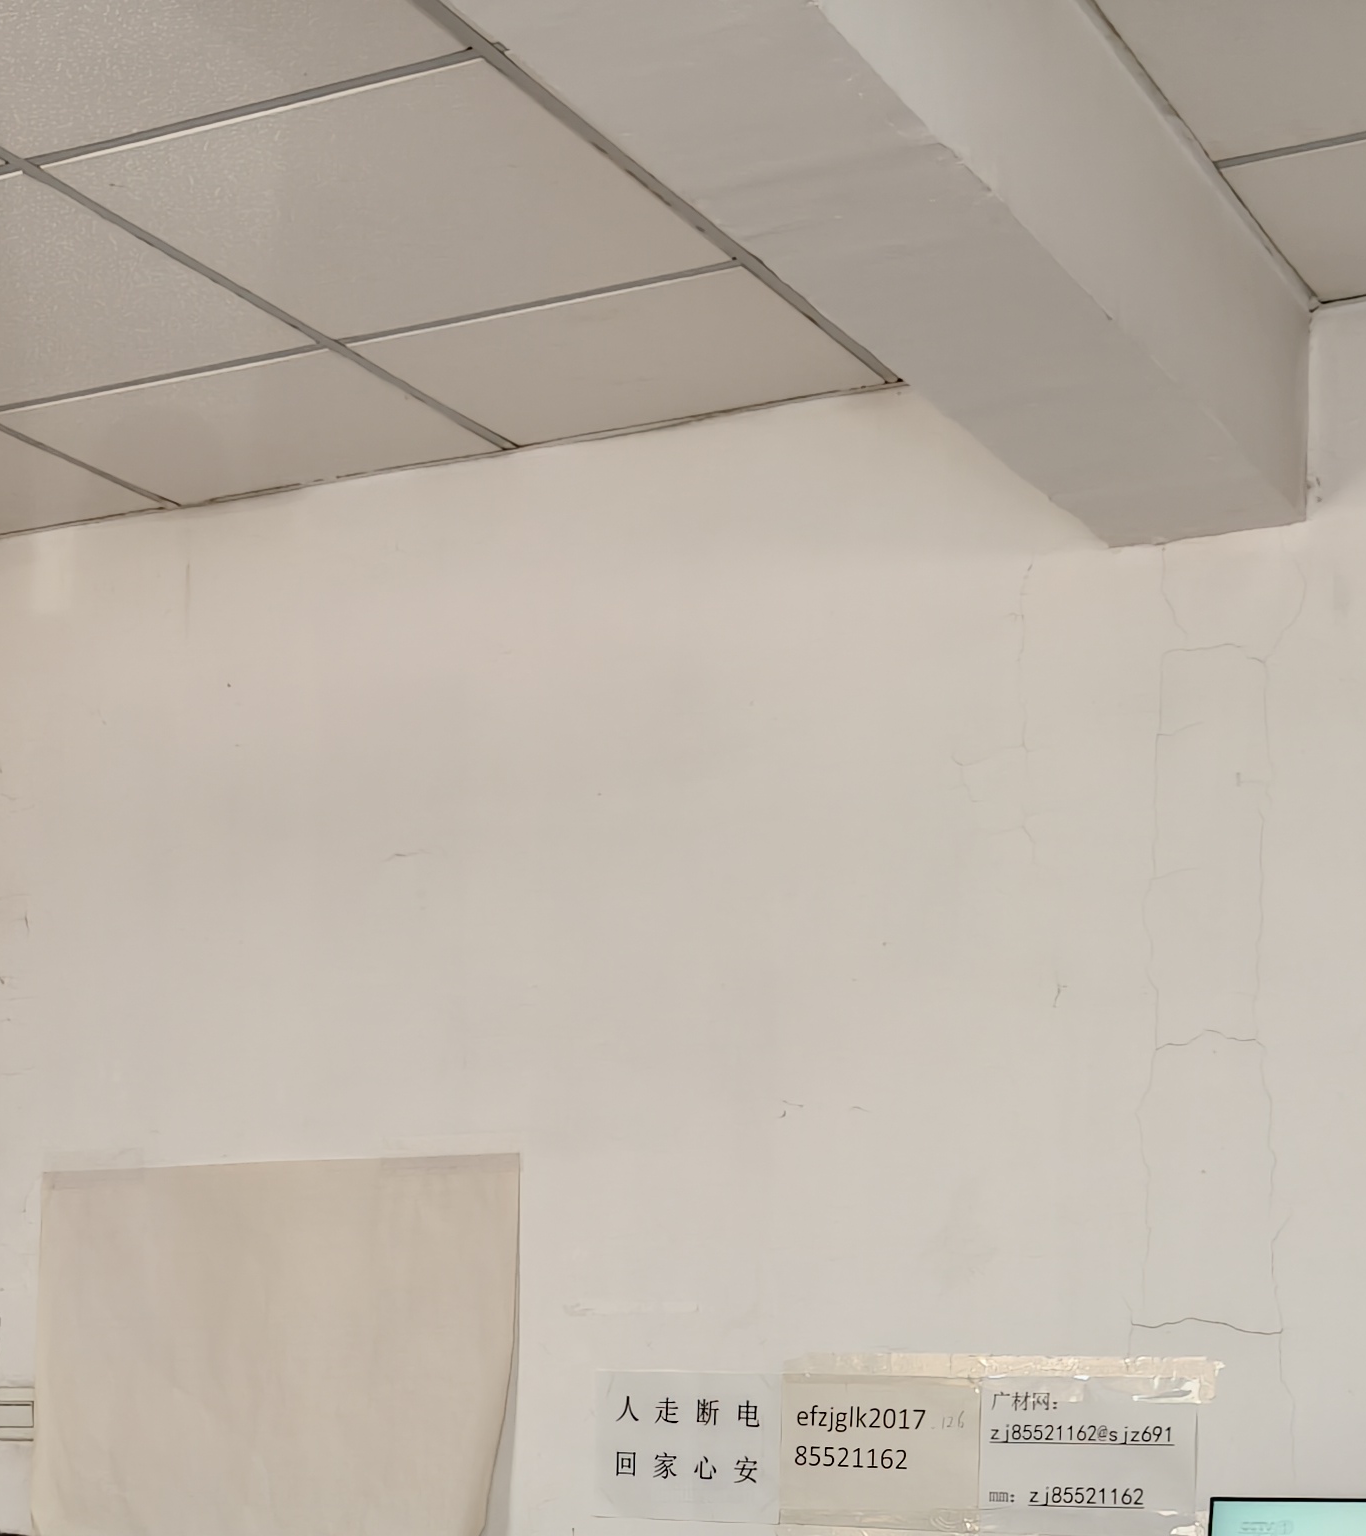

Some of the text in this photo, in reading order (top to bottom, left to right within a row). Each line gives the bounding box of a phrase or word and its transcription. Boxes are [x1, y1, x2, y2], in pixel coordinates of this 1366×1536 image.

[615, 1395, 760, 1428] 人走断电
[796, 1404, 926, 1433] efzjglk2017
[989, 1424, 1173, 1445] zj85521162@sjz691
[615, 1451, 759, 1484] 回家心安
[794, 1445, 908, 1470] 85521162
[1029, 1486, 1145, 1507] zj85521162
